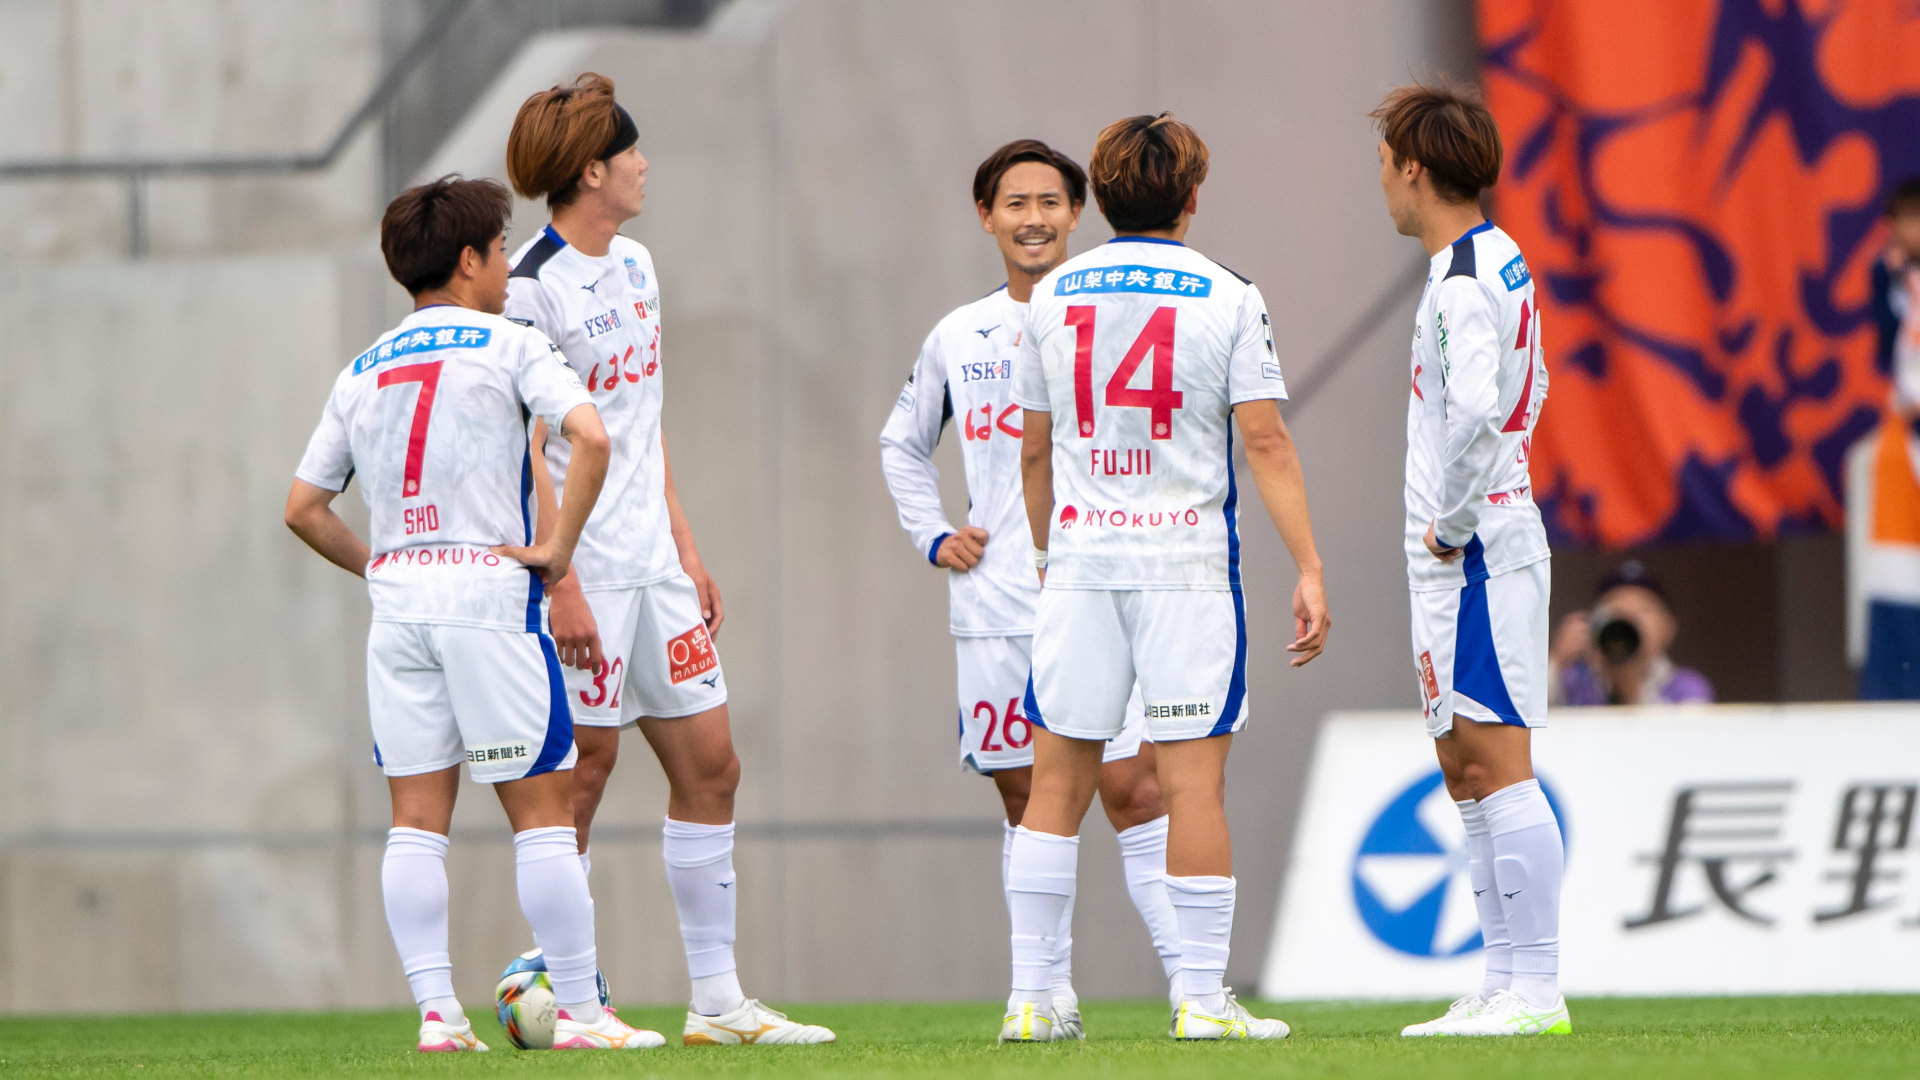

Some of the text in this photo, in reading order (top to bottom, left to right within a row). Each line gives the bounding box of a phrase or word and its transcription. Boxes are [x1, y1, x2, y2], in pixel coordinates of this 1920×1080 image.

[1064, 270, 1205, 293] 山梨中央銀行
[361, 327, 485, 371] 山梨中央銀行
[587, 325, 663, 392] はくば
[1064, 304, 1183, 440] 14
[377, 360, 444, 498] 7
[1091, 449, 1151, 475] FUJII
[404, 504, 440, 535] SHO
[1084, 508, 1199, 528] KYOKUYO
[389, 548, 500, 567] KYOKUYO
[579, 656, 624, 708] 32
[973, 697, 1032, 751] 26
